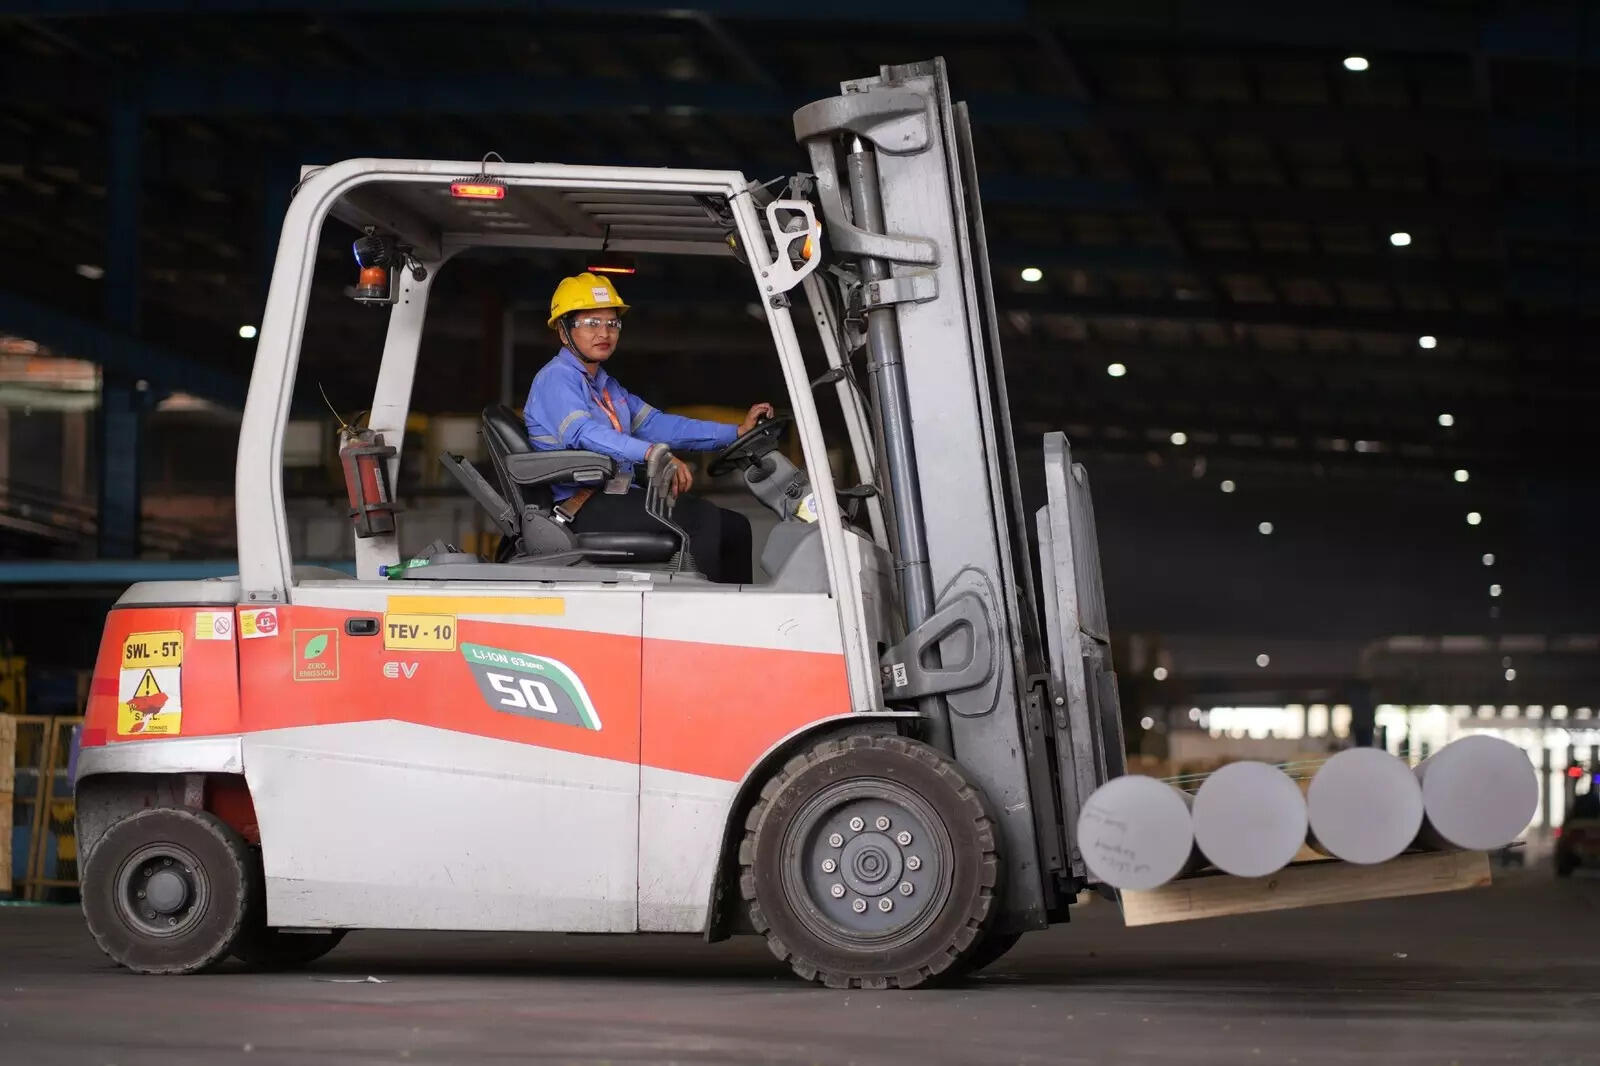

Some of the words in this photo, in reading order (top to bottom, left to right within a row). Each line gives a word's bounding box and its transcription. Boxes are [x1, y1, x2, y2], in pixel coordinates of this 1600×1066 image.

[388, 623, 420, 639] TEV
[433, 624, 452, 640] 10
[126, 643, 150, 659] SWL
[162, 641, 178, 657] 5T
[299, 669, 336, 677] EMISSION
[307, 662, 327, 670] ZERO
[383, 661, 419, 679] EV
[486, 671, 559, 714] 50
